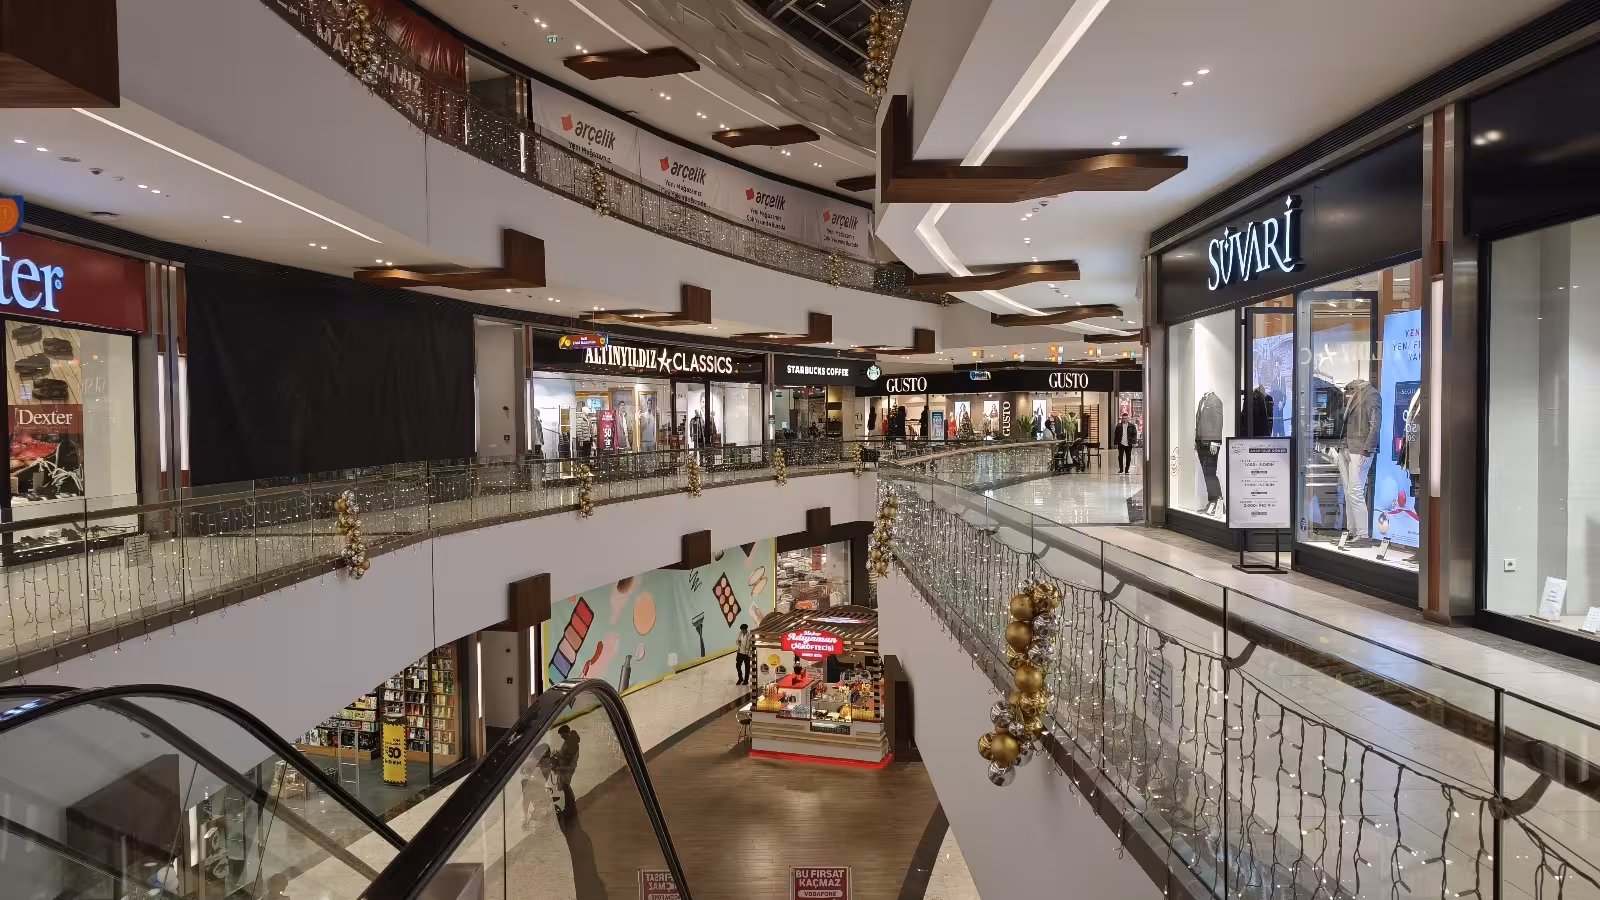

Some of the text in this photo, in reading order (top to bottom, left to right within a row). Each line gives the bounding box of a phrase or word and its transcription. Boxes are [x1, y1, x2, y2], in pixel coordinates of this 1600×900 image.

[574, 120, 616, 151] arçelik
[670, 161, 707, 186] arçelik
[755, 190, 786, 211] arçelik
[831, 212, 859, 231] arçelik
[585, 344, 733, 374] ALTINYILDIZ CLASSICS
[786, 364, 849, 377] STARBUCKS COFFEE
[885, 376, 928, 393] GUSTO
[1048, 372, 1089, 389] GUSTO
[18, 409, 73, 426] Dexter
[1002, 401, 1011, 437] GUSTO
[795, 869, 845, 878] BU FIRSAT
[798, 878, 842, 889] KAÇMAZ
